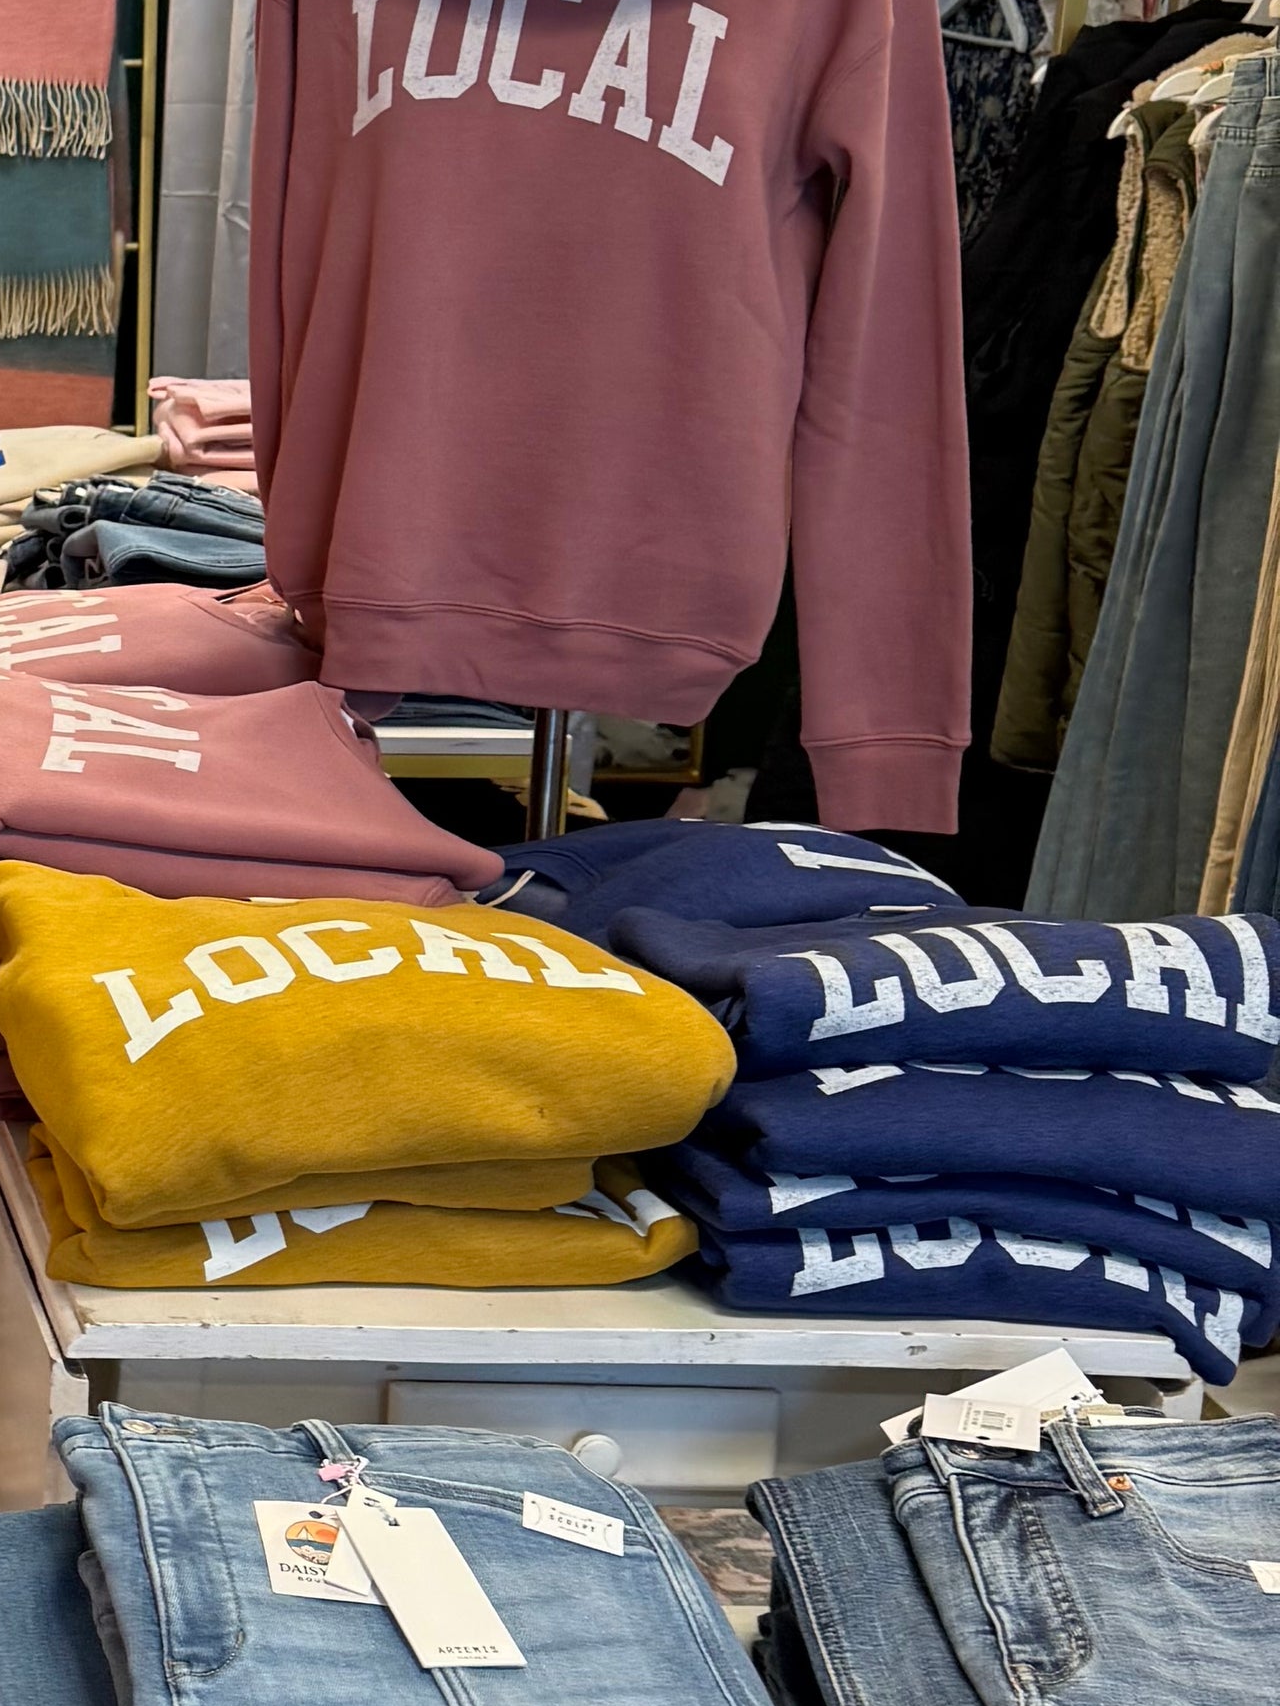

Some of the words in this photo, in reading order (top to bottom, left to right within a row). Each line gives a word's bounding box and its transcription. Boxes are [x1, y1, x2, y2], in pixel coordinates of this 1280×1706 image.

[92, 919, 646, 1064] LOCAL
[776, 913, 1280, 1046] LOCAL
[279, 1562, 328, 1577] DAISY
